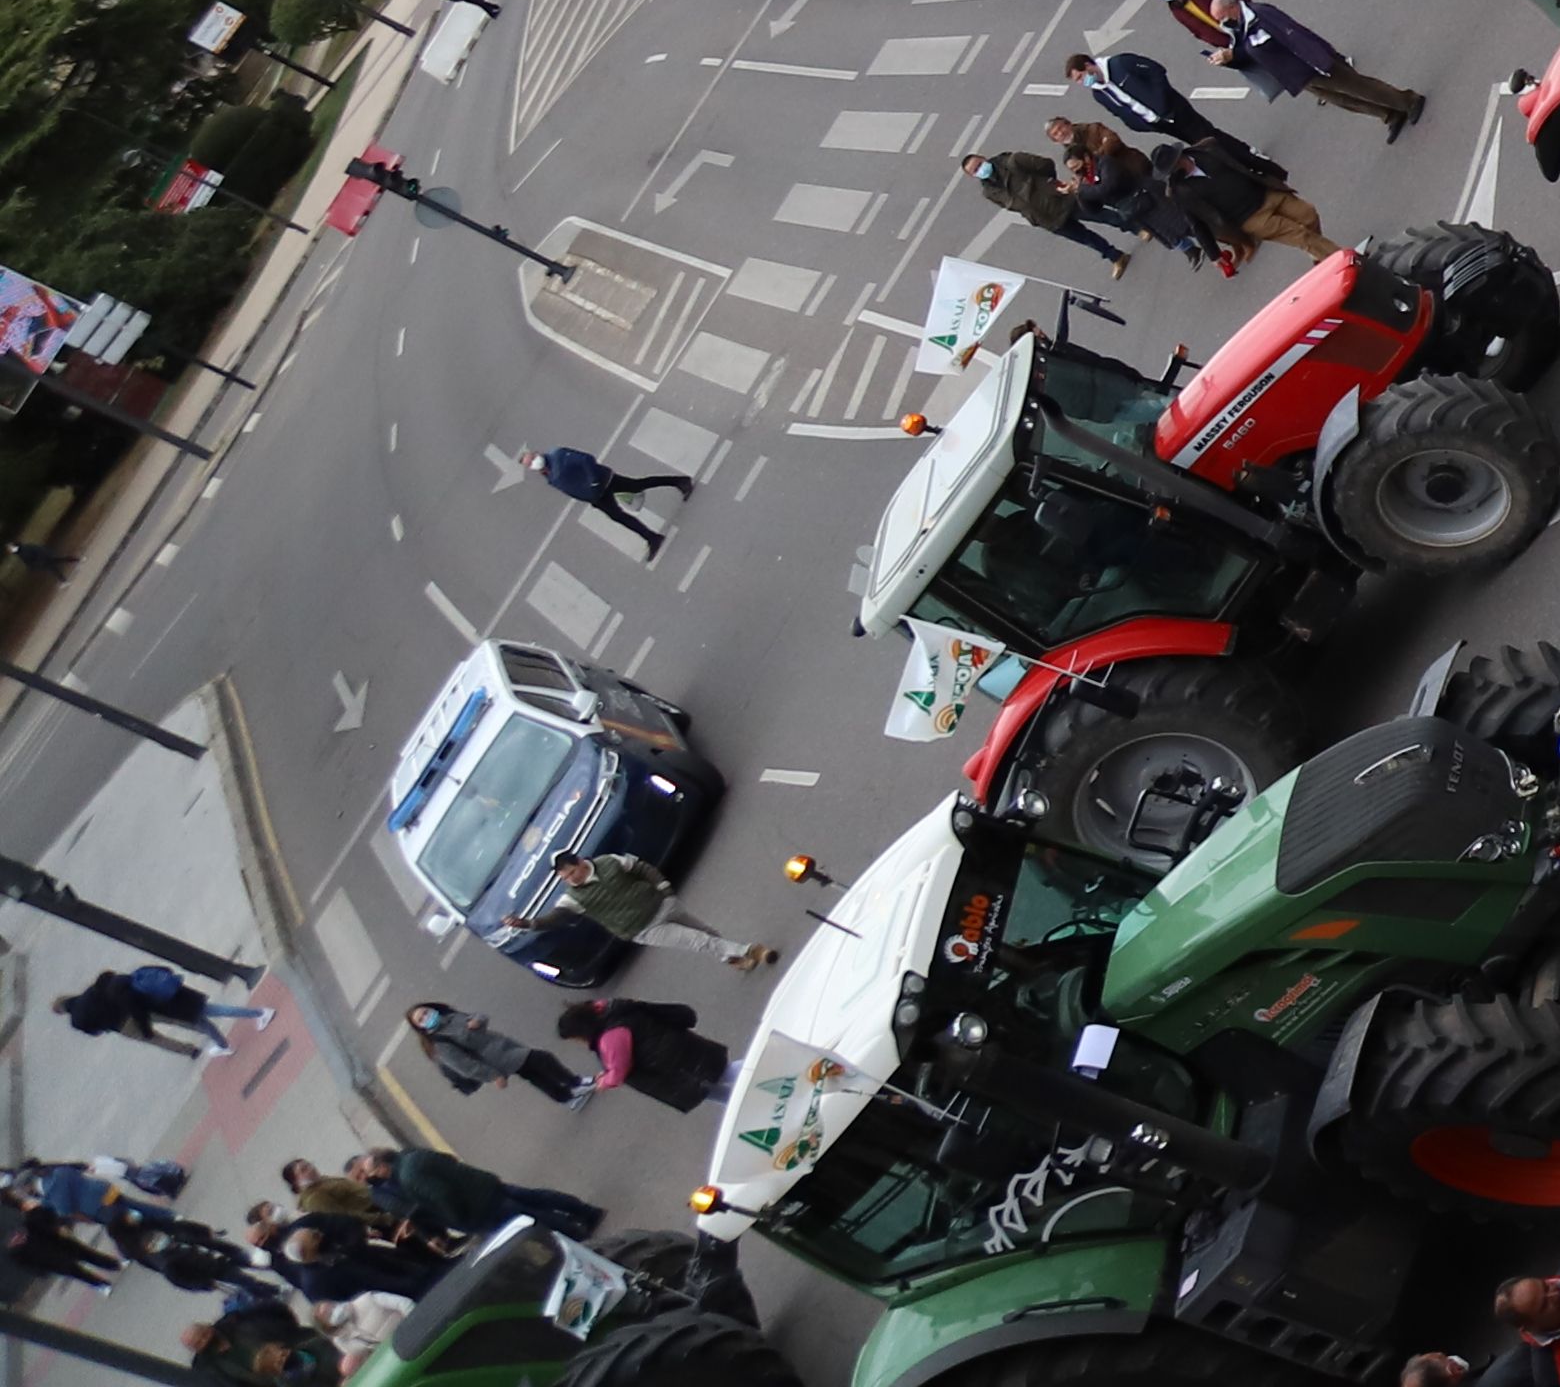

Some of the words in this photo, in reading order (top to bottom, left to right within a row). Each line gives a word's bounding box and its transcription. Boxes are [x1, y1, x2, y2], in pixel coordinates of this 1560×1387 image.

[1193, 417, 1231, 453] MASSEY
[1227, 372, 1276, 418] FERGUSON
[1222, 417, 1257, 451] 5460
[1442, 739, 1469, 792] FENDT
[508, 790, 580, 900] POLICIA
